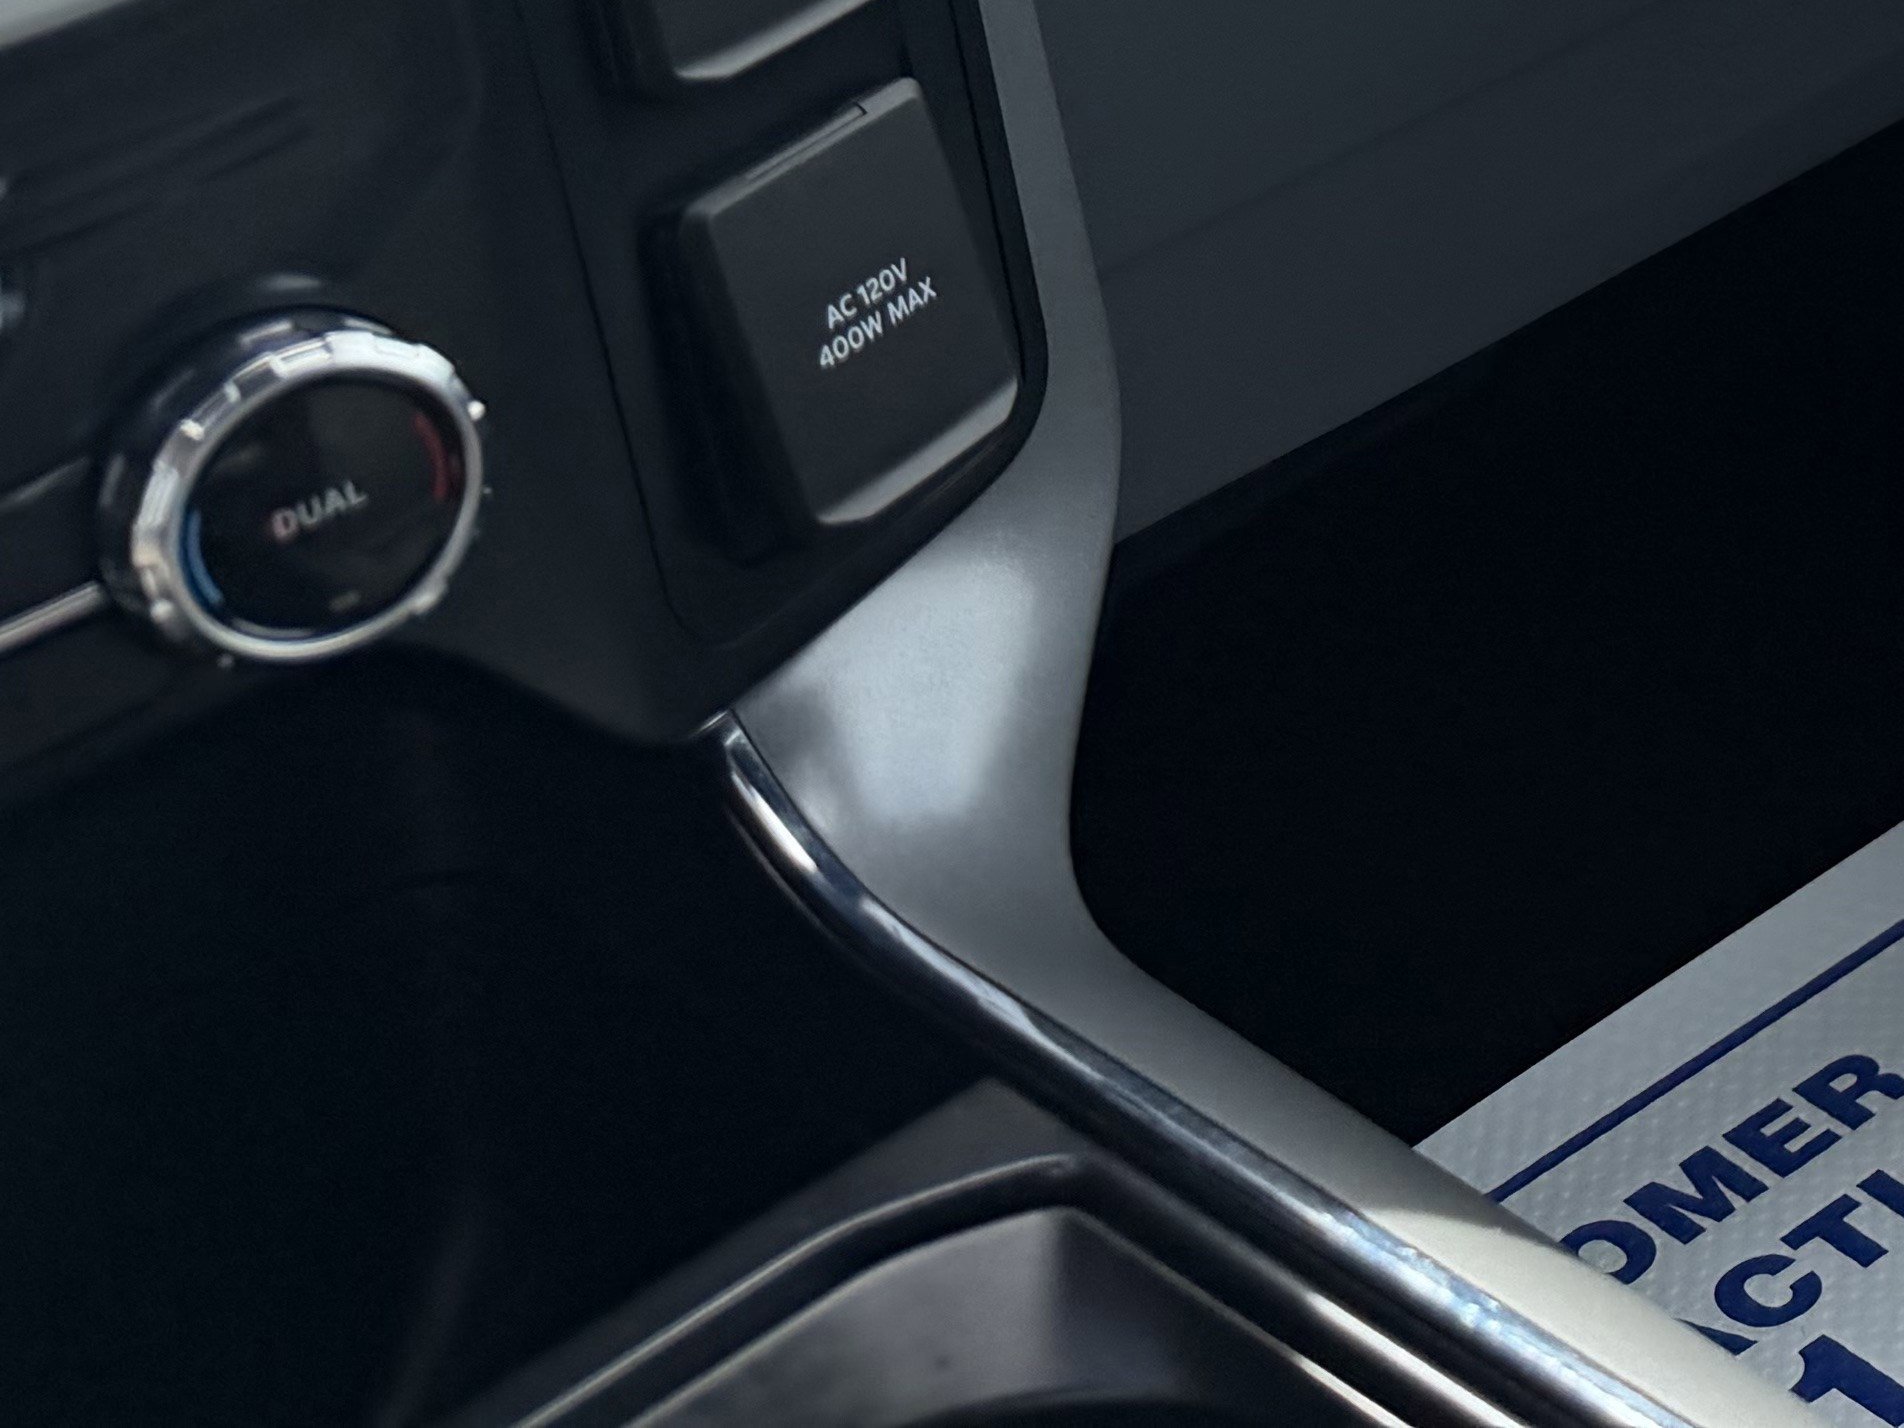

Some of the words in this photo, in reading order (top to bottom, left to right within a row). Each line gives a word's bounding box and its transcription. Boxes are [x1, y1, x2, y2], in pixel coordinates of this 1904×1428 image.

[819, 310, 884, 367] 400W
[886, 276, 938, 326] MAX
[826, 293, 858, 330] AC
[856, 257, 908, 307] 120V
[272, 480, 368, 539] DUAL
